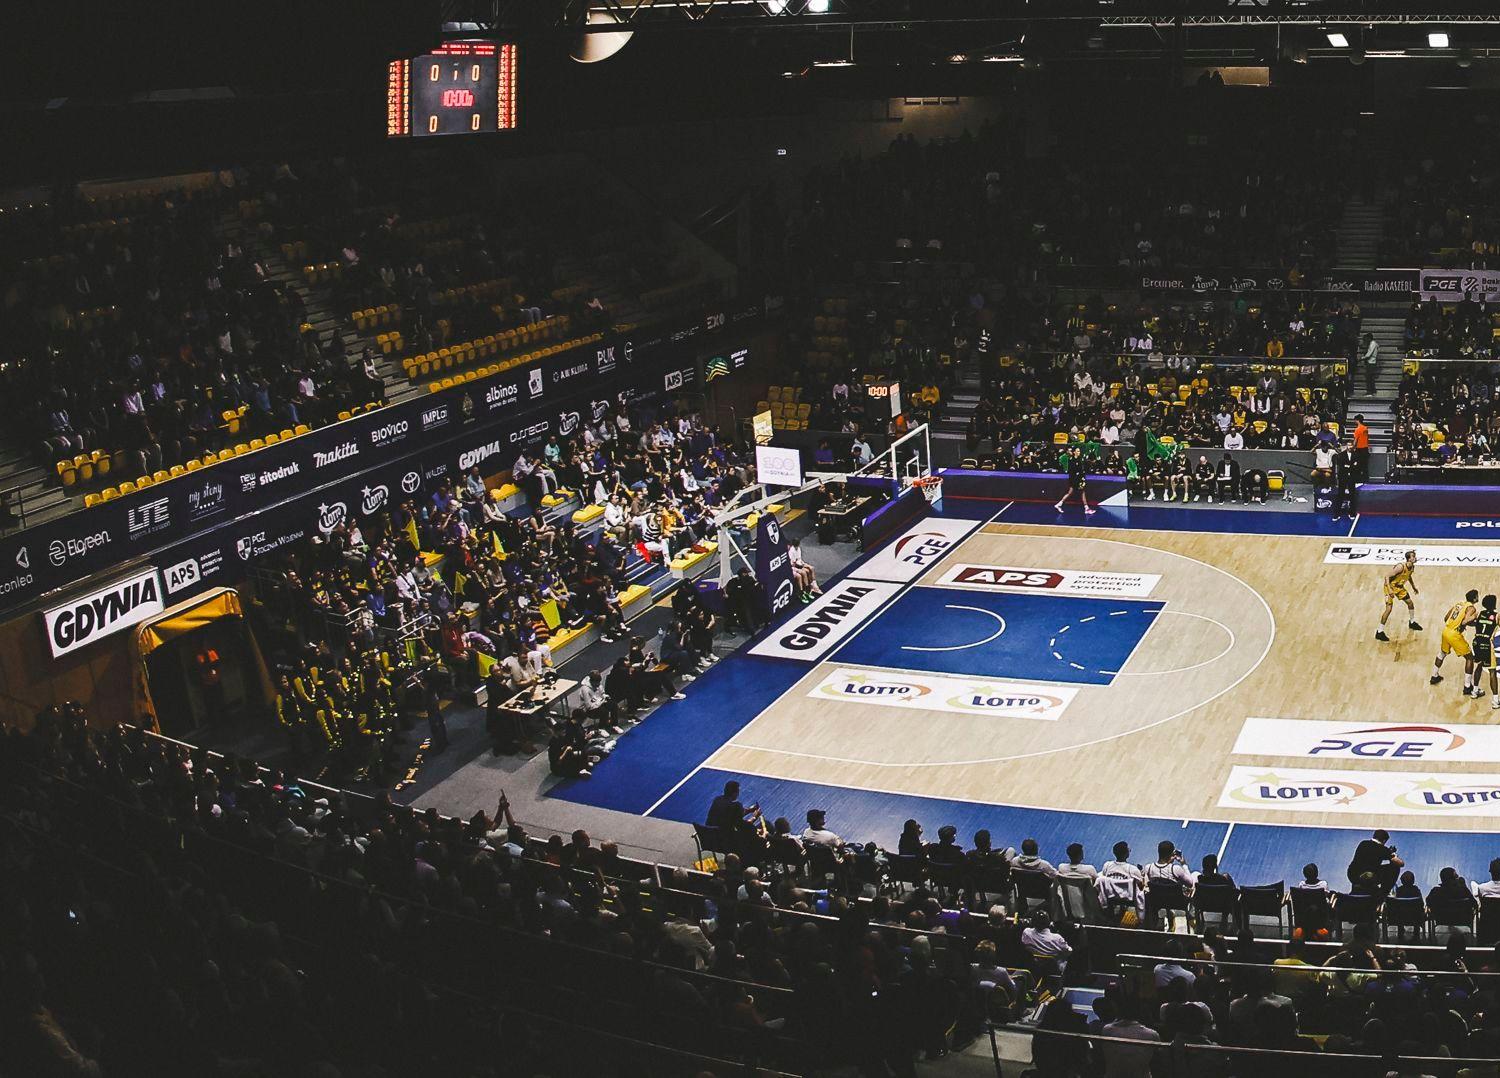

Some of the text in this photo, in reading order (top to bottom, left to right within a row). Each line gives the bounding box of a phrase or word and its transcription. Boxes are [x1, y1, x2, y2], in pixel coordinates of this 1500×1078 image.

[430, 64, 439, 82] 0
[471, 64, 480, 81] 0
[429, 113, 480, 133] 0 0
[1429, 279, 1458, 290] PGE
[596, 346, 616, 366] PUK
[485, 383, 518, 403] albinos
[868, 386, 887, 397] 10:00
[509, 421, 549, 443] asseco
[459, 440, 500, 471] GDYNIA
[260, 462, 299, 486] sitodruk
[128, 497, 170, 533] LTE
[67, 530, 111, 557] Elgreen
[903, 538, 951, 566] PGE
[170, 564, 195, 588] APS
[964, 570, 1053, 586] APS
[1073, 579, 1142, 587] protection
[1078, 574, 1143, 582] advanced
[773, 590, 790, 614] PGE
[53, 577, 158, 650] GDYNIA
[779, 585, 877, 651] GDYNIA
[844, 683, 910, 695] LOTTO
[971, 695, 1041, 707] LOTTO
[1308, 739, 1434, 758] PGE
[1259, 785, 1341, 800] LOTTO
